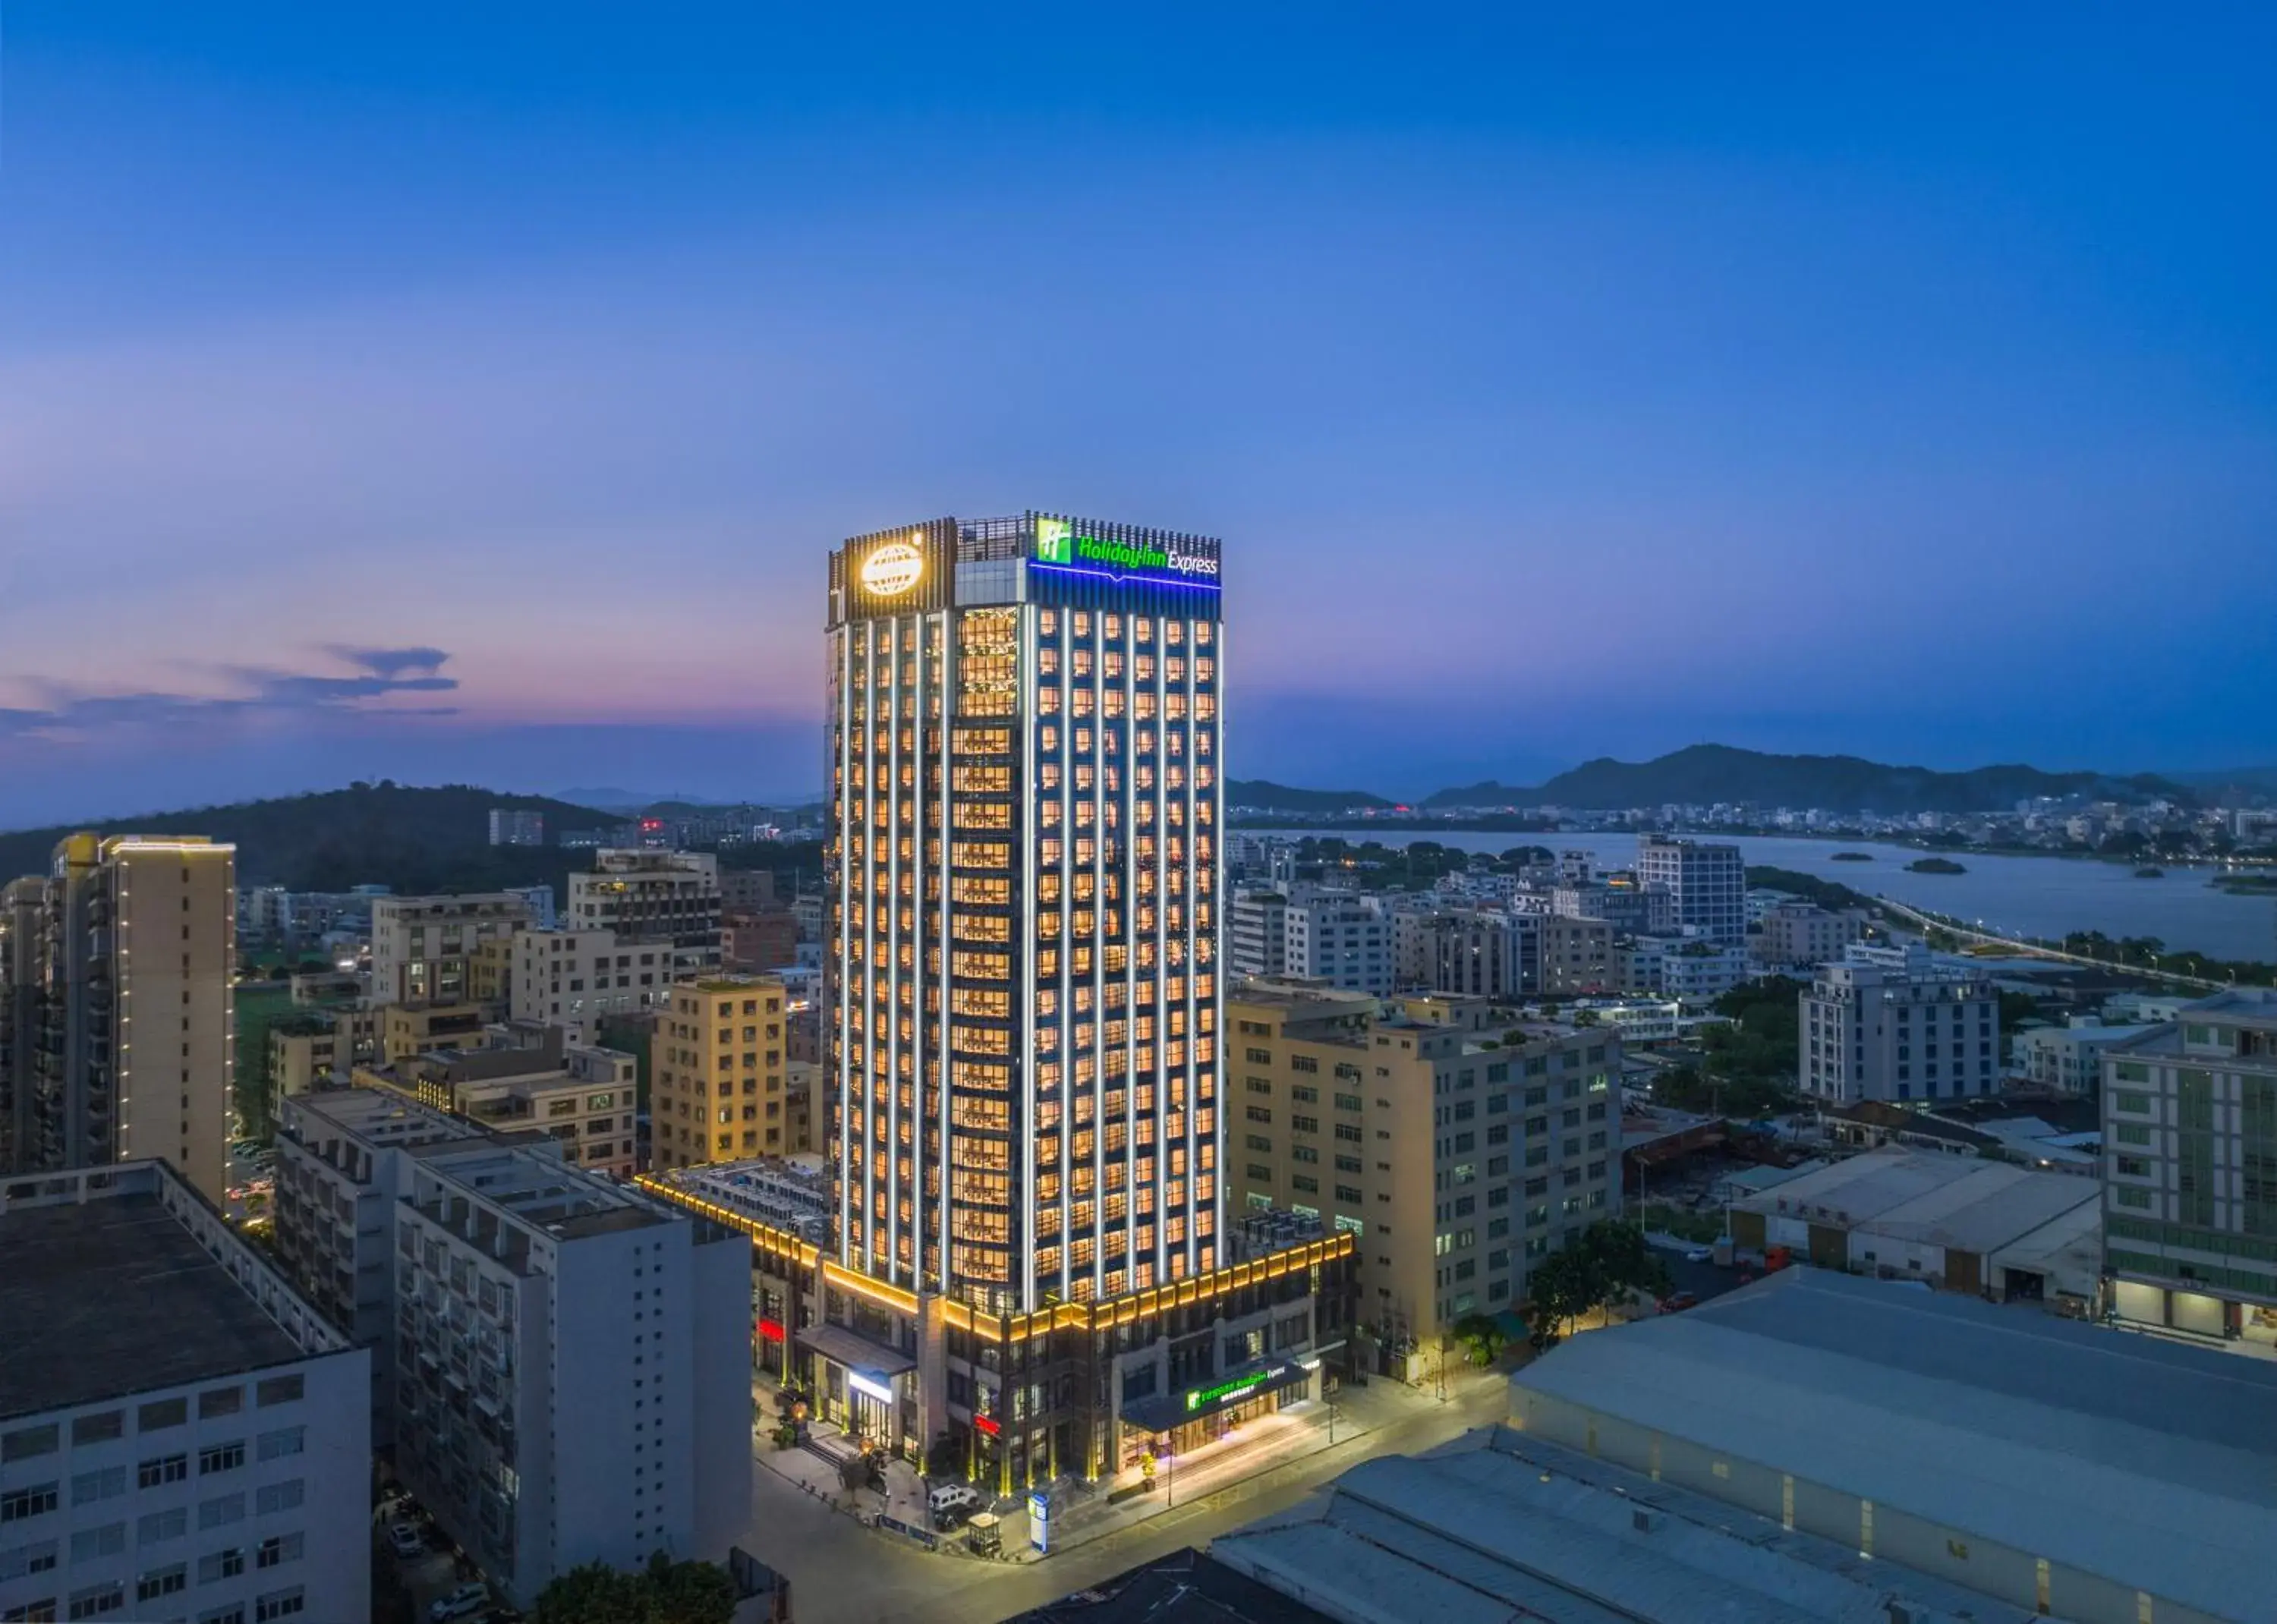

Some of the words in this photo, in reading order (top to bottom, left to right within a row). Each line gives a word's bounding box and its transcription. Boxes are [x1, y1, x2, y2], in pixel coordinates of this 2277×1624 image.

[1079, 536, 1139, 568] Holiday
[1142, 544, 1167, 566] Inn
[1168, 551, 1217, 575] Express
